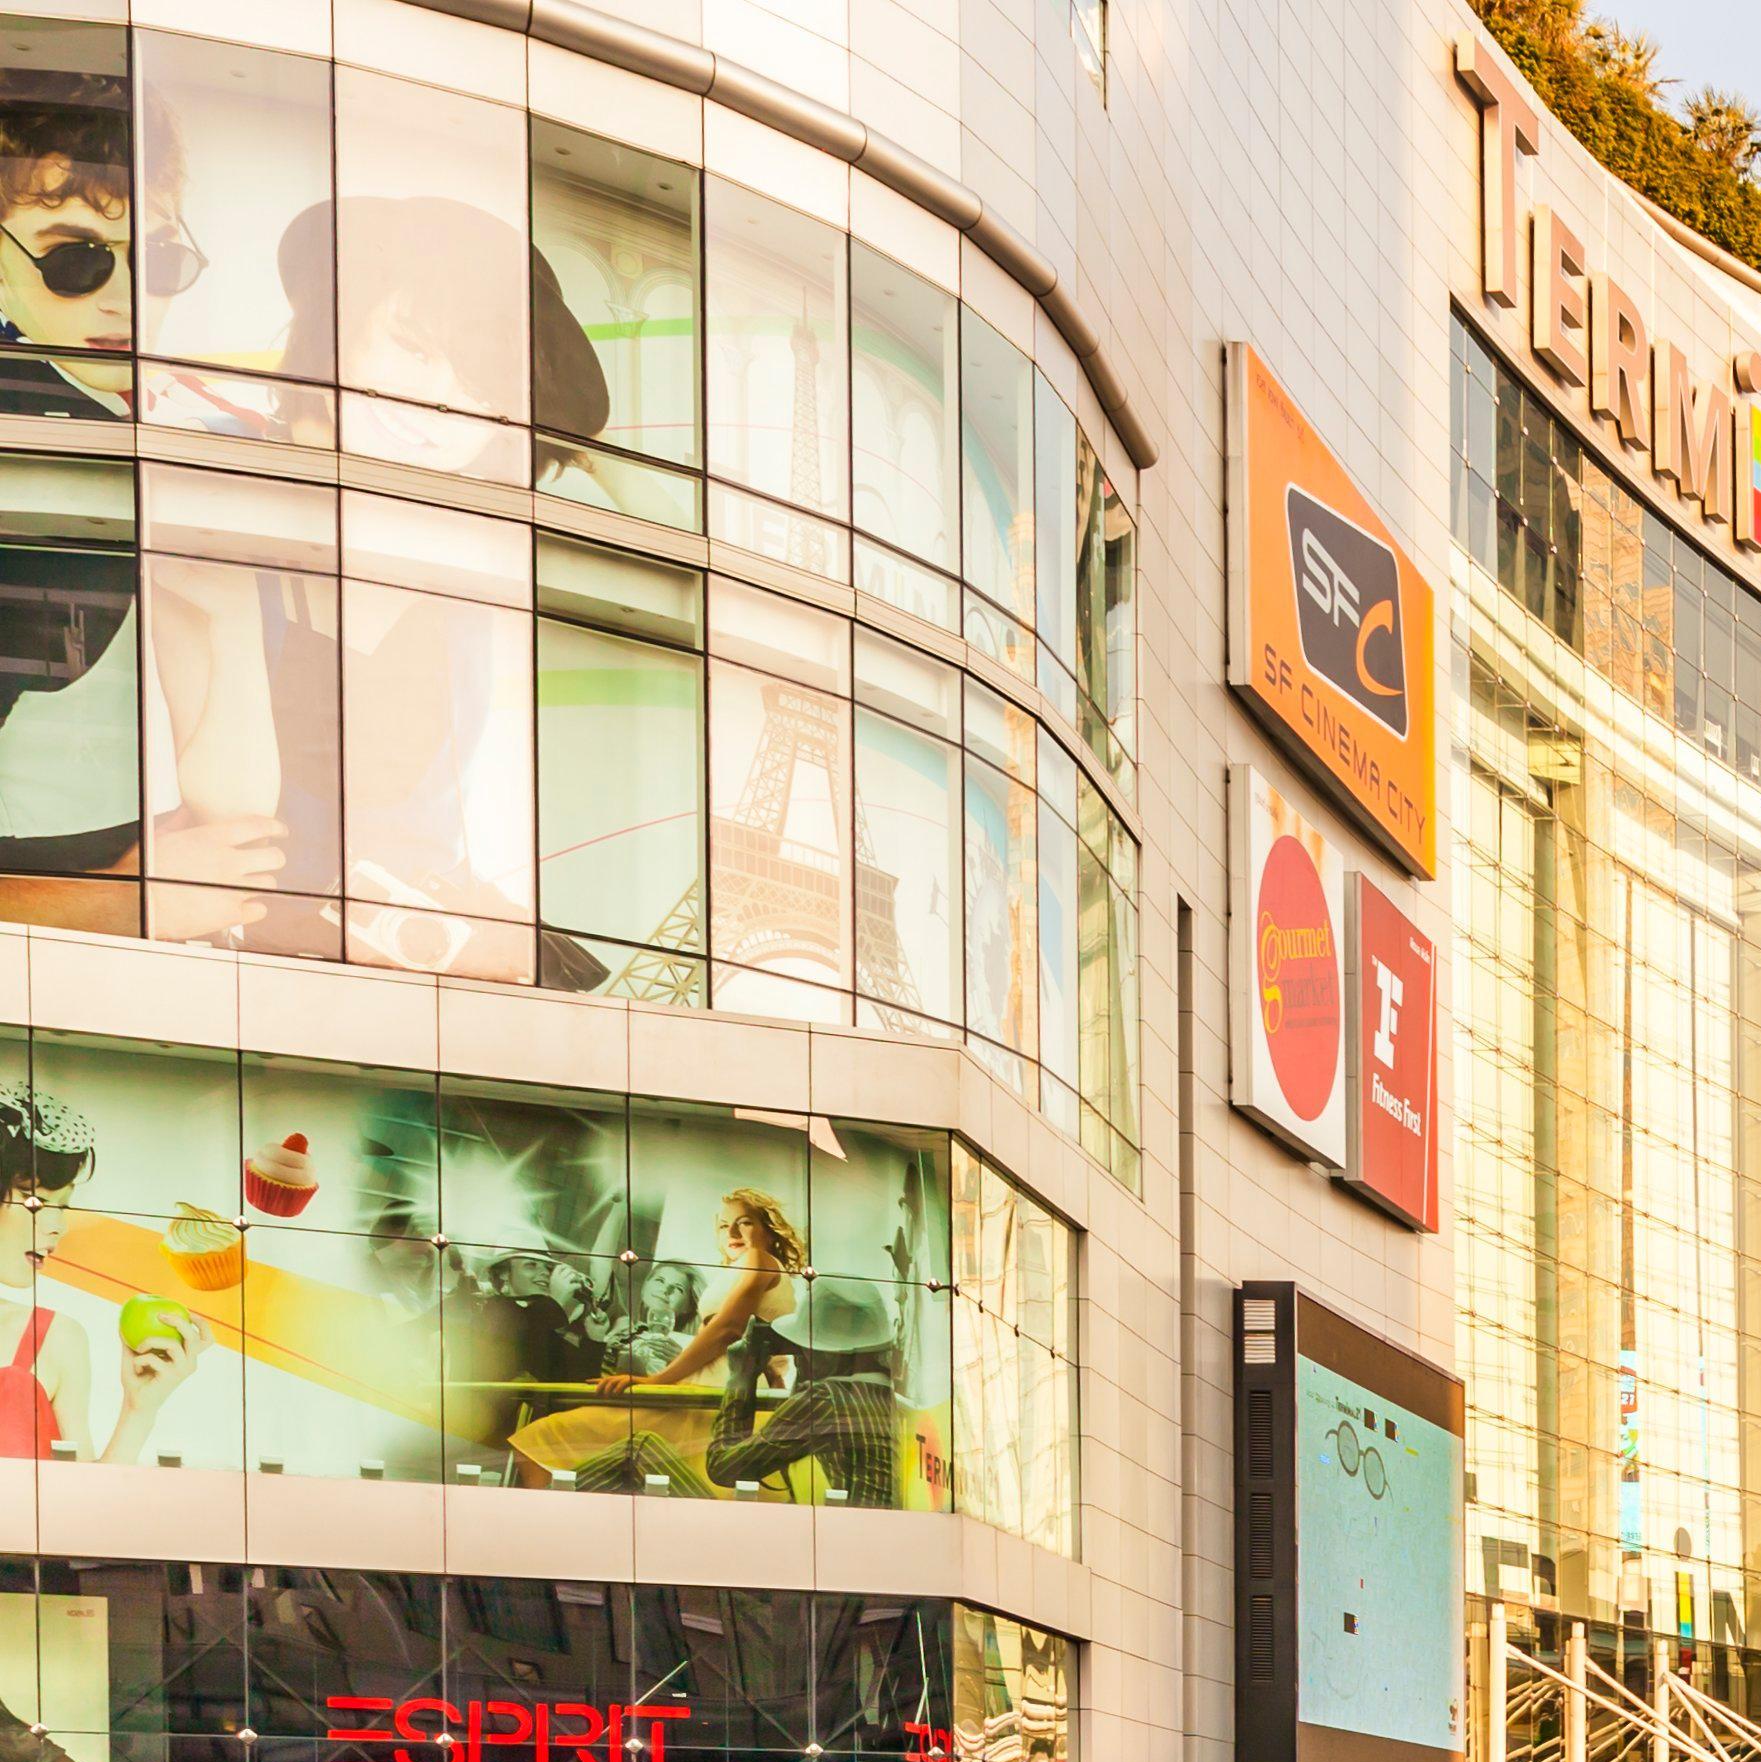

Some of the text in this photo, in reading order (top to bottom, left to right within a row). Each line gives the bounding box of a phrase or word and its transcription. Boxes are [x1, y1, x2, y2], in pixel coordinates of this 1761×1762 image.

[1264, 643, 1426, 845] SF CINEMA CITY
[1260, 911, 1332, 1034] gourmet
[1281, 962, 1336, 1010] market
